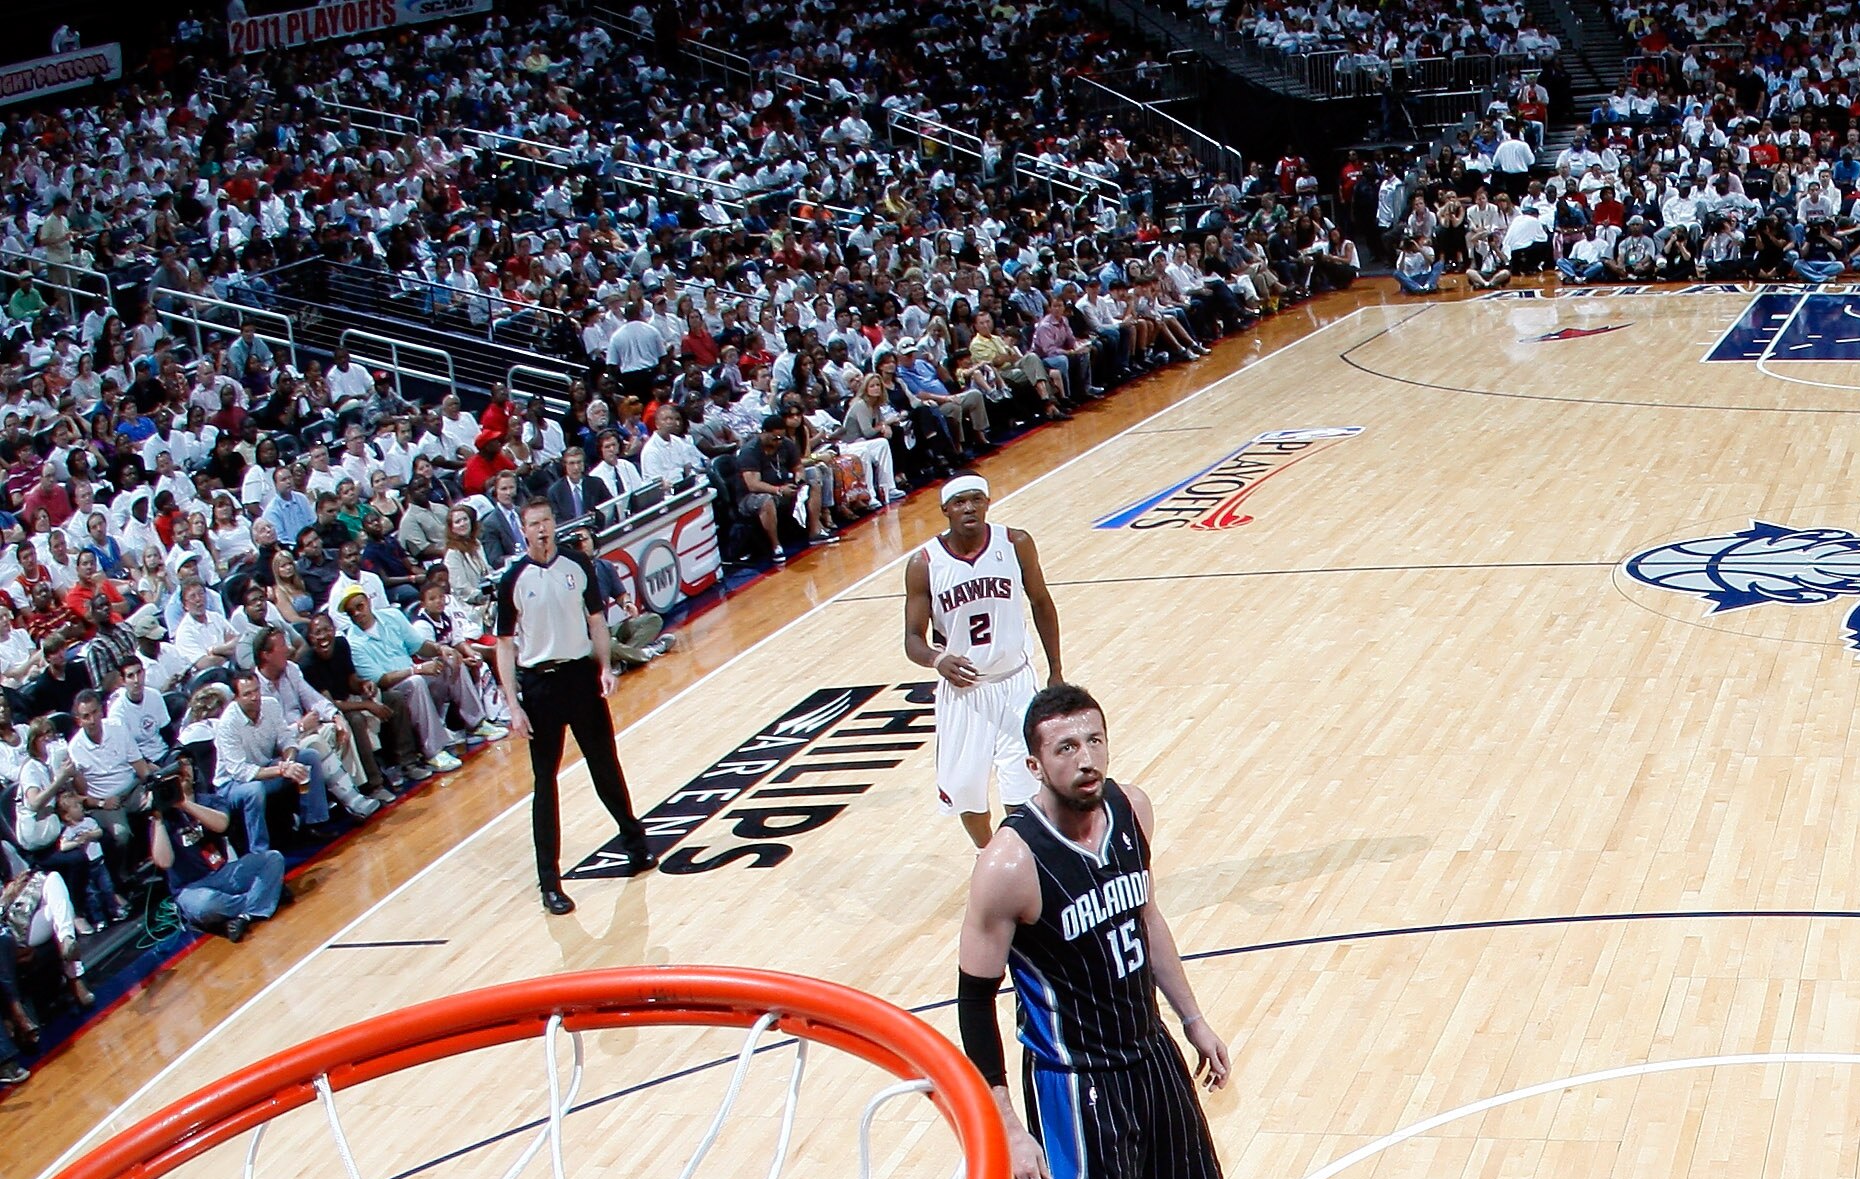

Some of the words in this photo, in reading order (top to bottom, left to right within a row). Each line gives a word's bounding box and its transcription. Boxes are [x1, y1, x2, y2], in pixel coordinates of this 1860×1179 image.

[231, 15, 282, 50] 2011
[287, 0, 397, 45] PLAYOFFS
[1130, 441, 1313, 529] PLAYOFFS
[645, 564, 676, 596] TNT
[938, 576, 1012, 614] HAWKS
[969, 612, 992, 646] 2
[1106, 918, 1145, 979] 15
